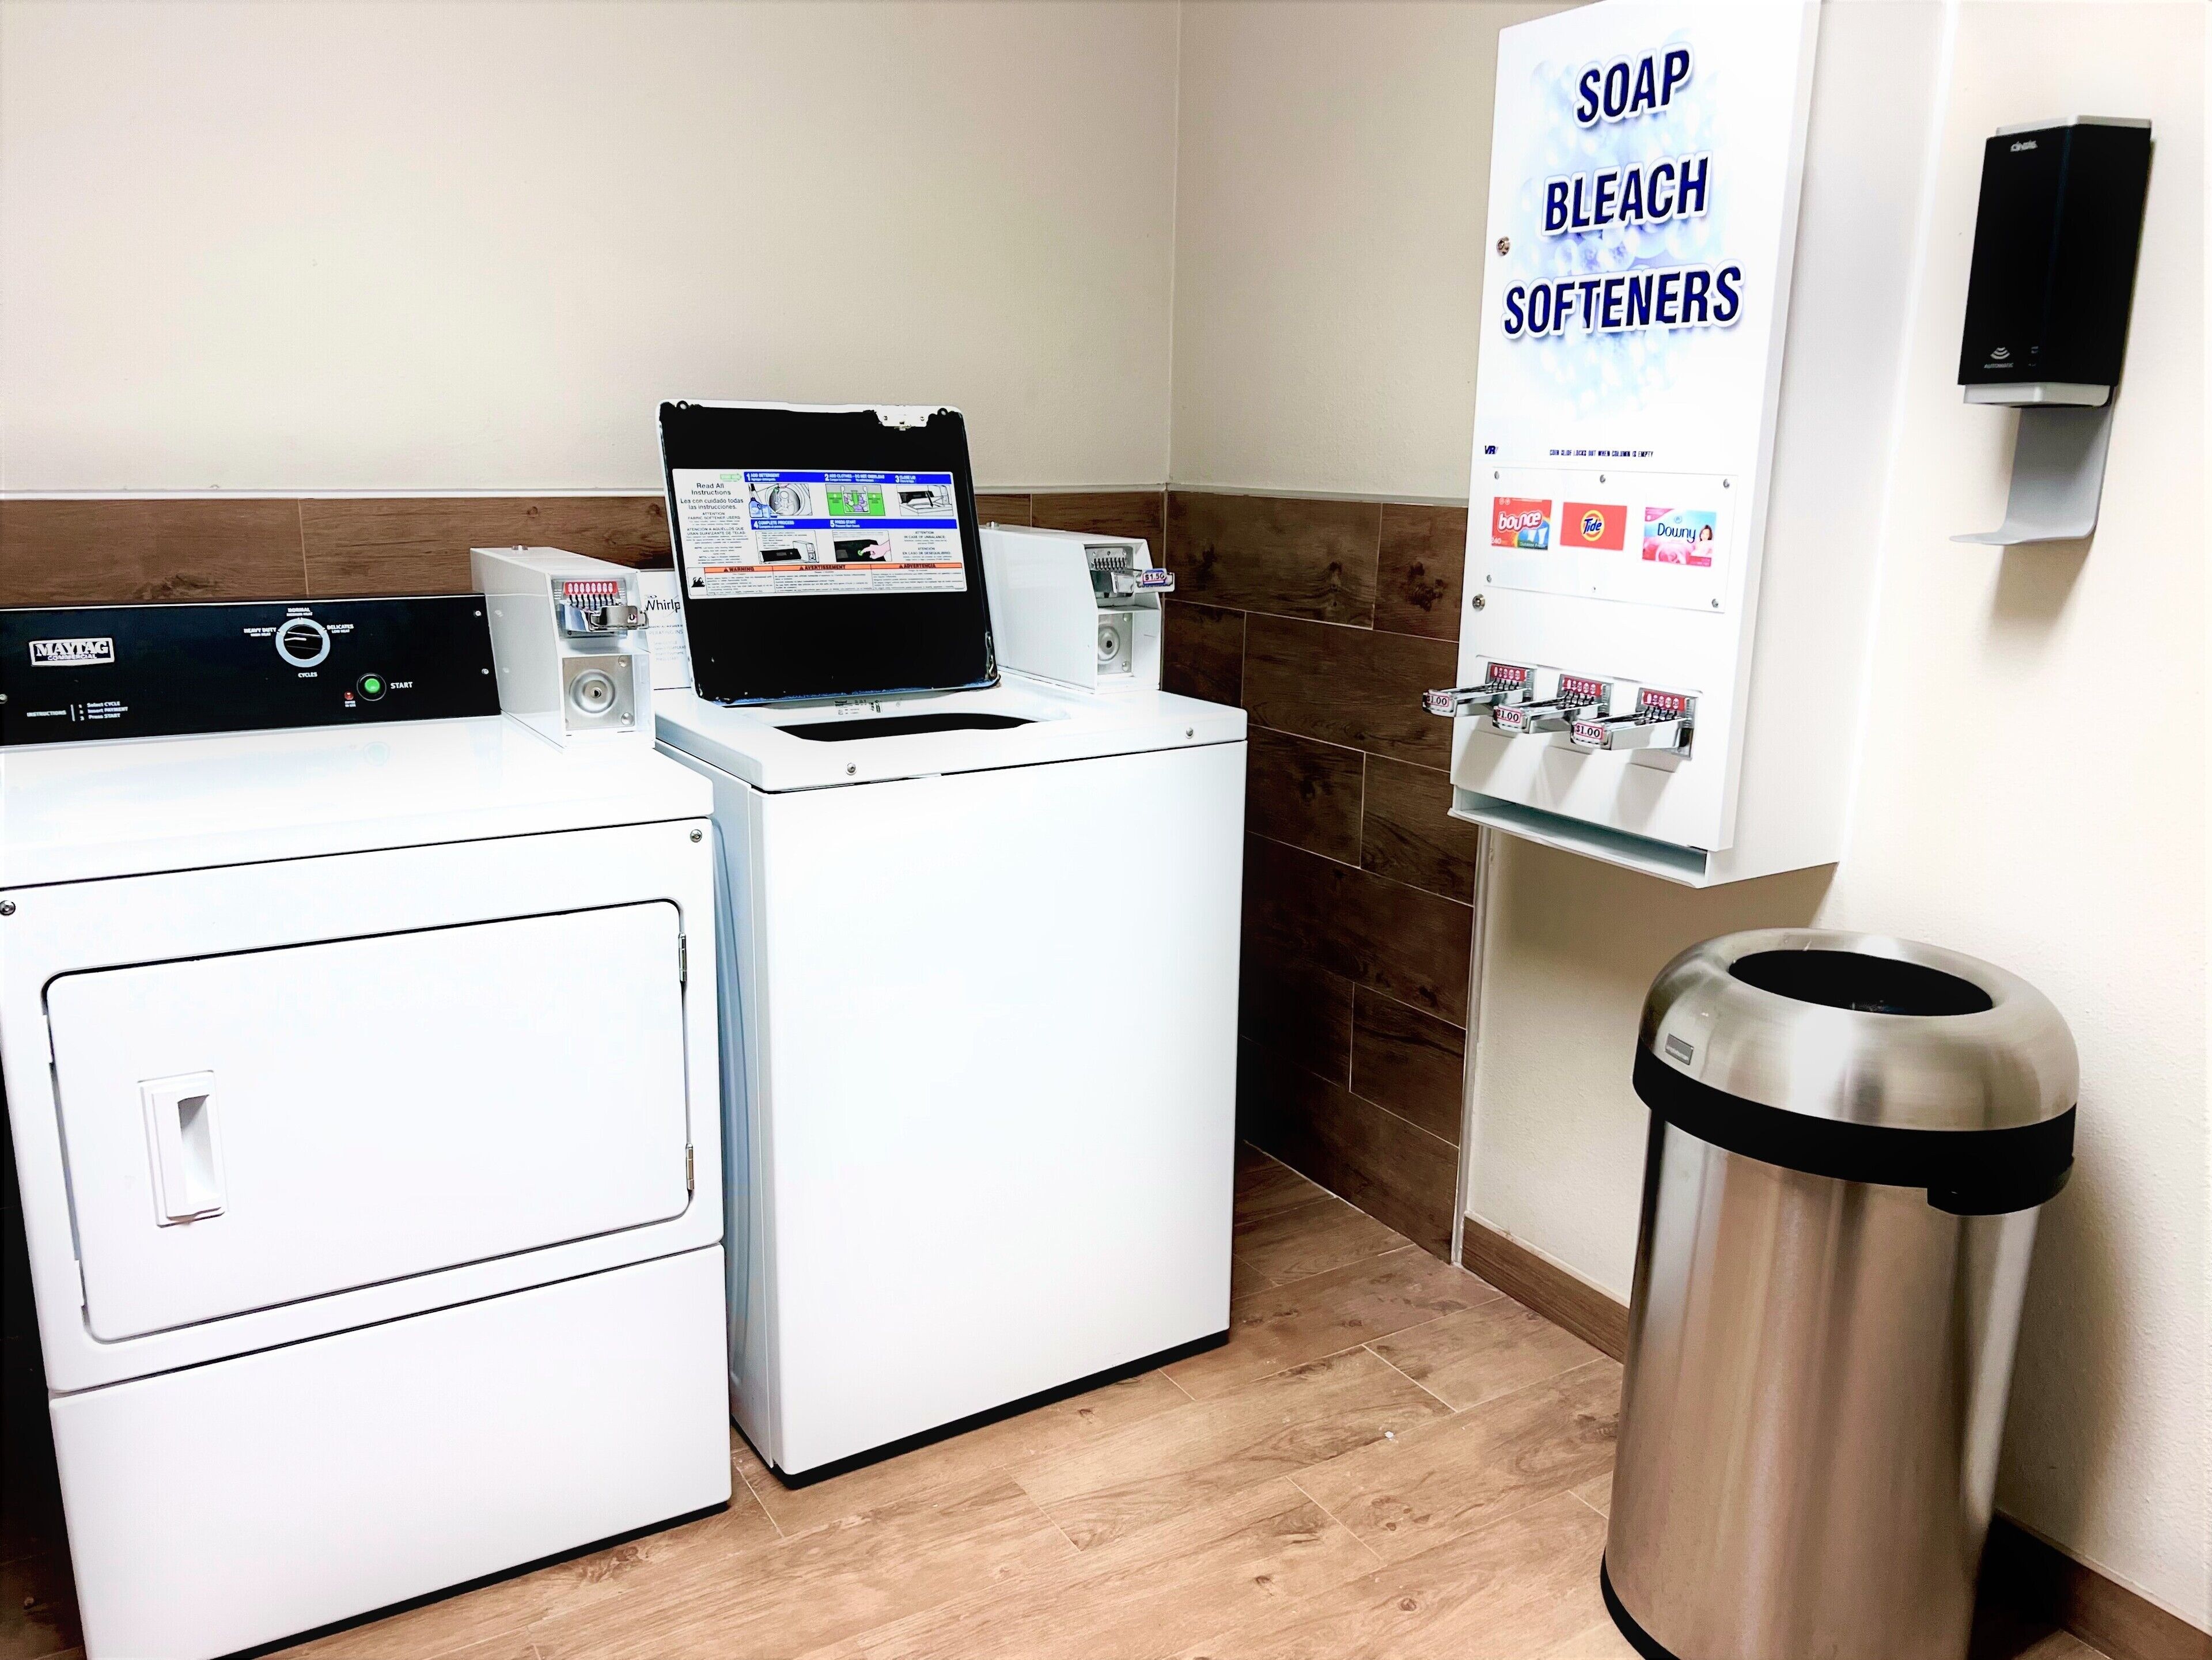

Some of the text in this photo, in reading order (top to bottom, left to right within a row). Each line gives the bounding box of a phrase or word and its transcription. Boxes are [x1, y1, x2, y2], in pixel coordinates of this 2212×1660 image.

[1576, 49, 1690, 123] SOAP
[1544, 156, 1709, 232] BLEACH
[1504, 265, 1742, 335] SOFTENERS
[747, 473, 751, 481] 1
[824, 473, 830, 482] 2
[753, 521, 758, 529] 4
[830, 520, 835, 528] 5
[1498, 512, 1542, 532] bounce
[1583, 518, 1602, 534] Tide
[1657, 522, 1696, 543] Downy
[35, 640, 108, 657] MAYTAG
[1426, 695, 1447, 706] $1.00
[1497, 709, 1519, 722] $1.00
[1575, 725, 1600, 737] $1.00
